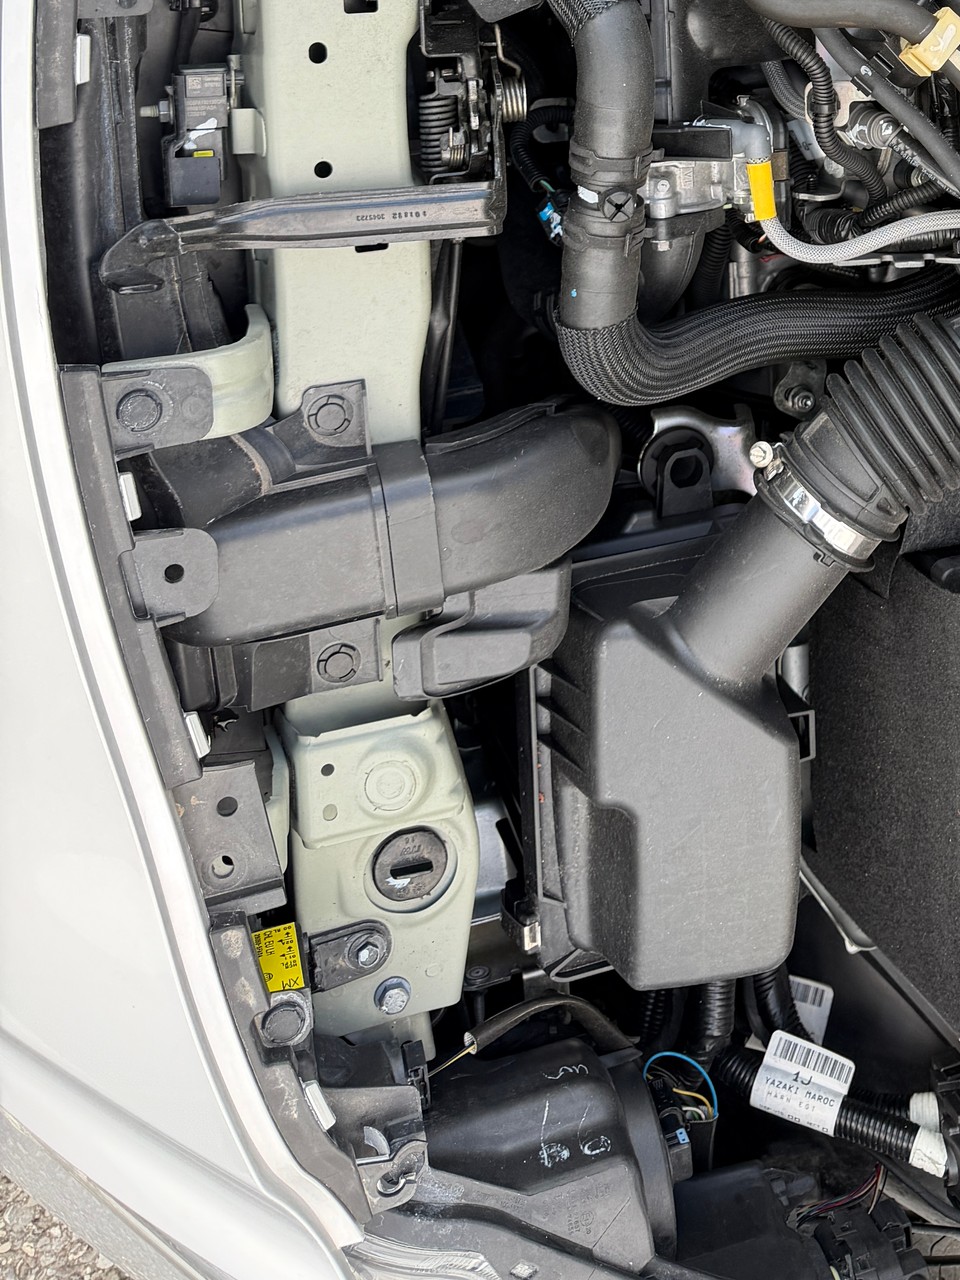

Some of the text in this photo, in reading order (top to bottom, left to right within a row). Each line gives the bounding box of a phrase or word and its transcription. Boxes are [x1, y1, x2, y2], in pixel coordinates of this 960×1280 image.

[793, 1070, 813, 1086] 1J
[765, 1076, 836, 1108] YAZAKI MAROC
